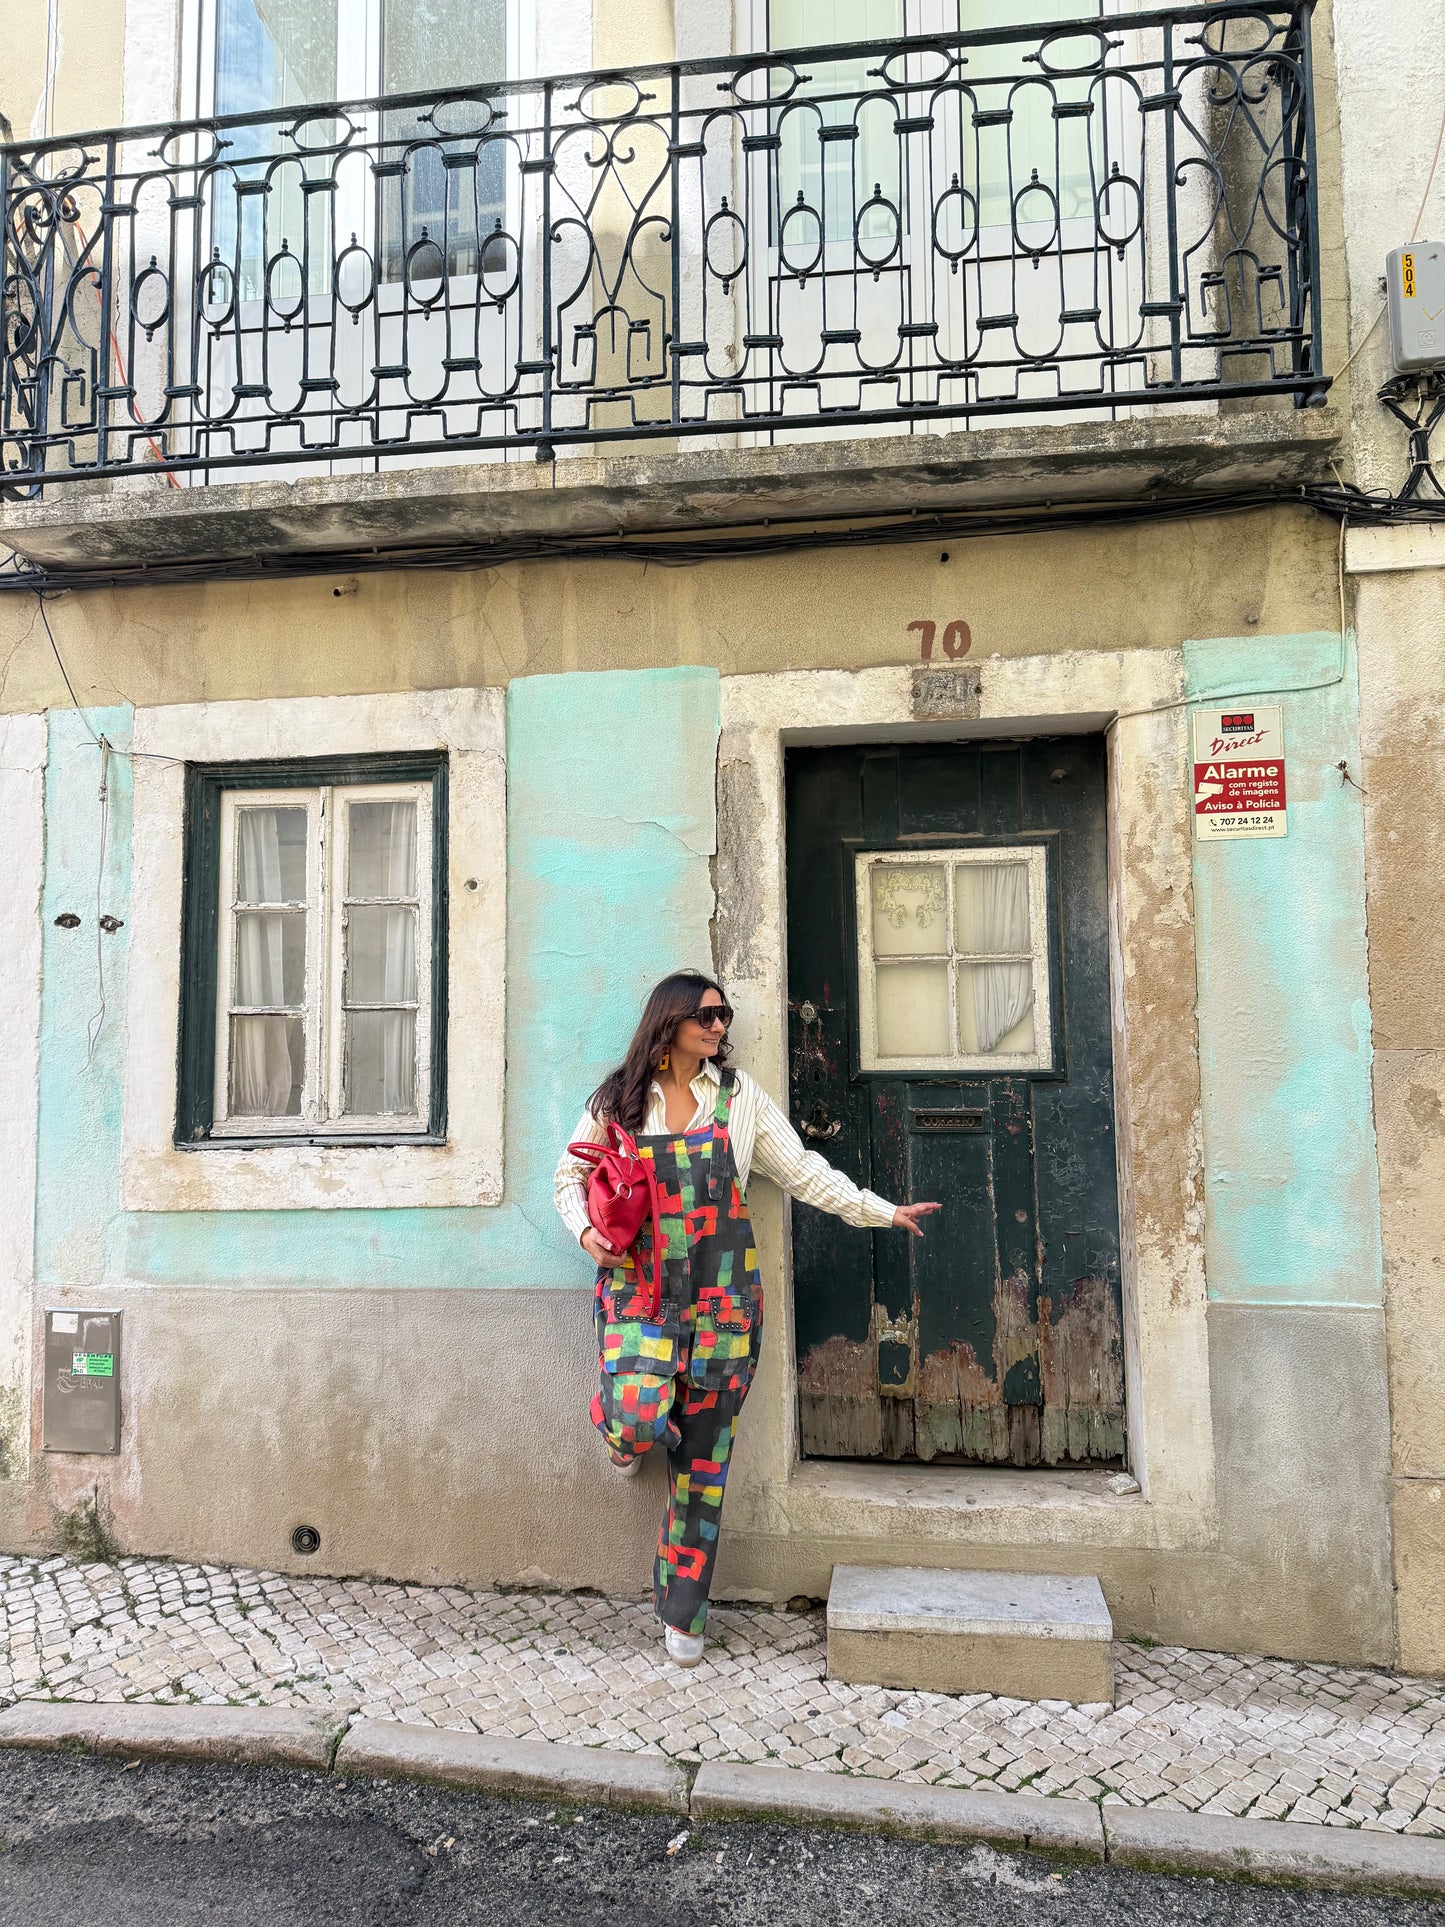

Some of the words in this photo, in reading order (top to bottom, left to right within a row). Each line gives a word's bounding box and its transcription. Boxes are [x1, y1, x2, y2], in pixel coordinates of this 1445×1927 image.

[906, 620, 972, 663] 70
[1209, 729, 1271, 757] Direct
[1203, 764, 1279, 780] Alarme
[1248, 780, 1279, 789] registo
[1229, 788, 1240, 796] de
[1243, 788, 1279, 797] imagens
[1204, 801, 1234, 811] Aviso
[1236, 800, 1243, 809] à
[1246, 799, 1280, 809] Polícia
[1220, 817, 1235, 826] 707
[1237, 817, 1249, 825] 24
[1251, 816, 1261, 824] 12
[1263, 816, 1274, 824] 24
[1211, 825, 1275, 833] www.securitasdirect.pt
